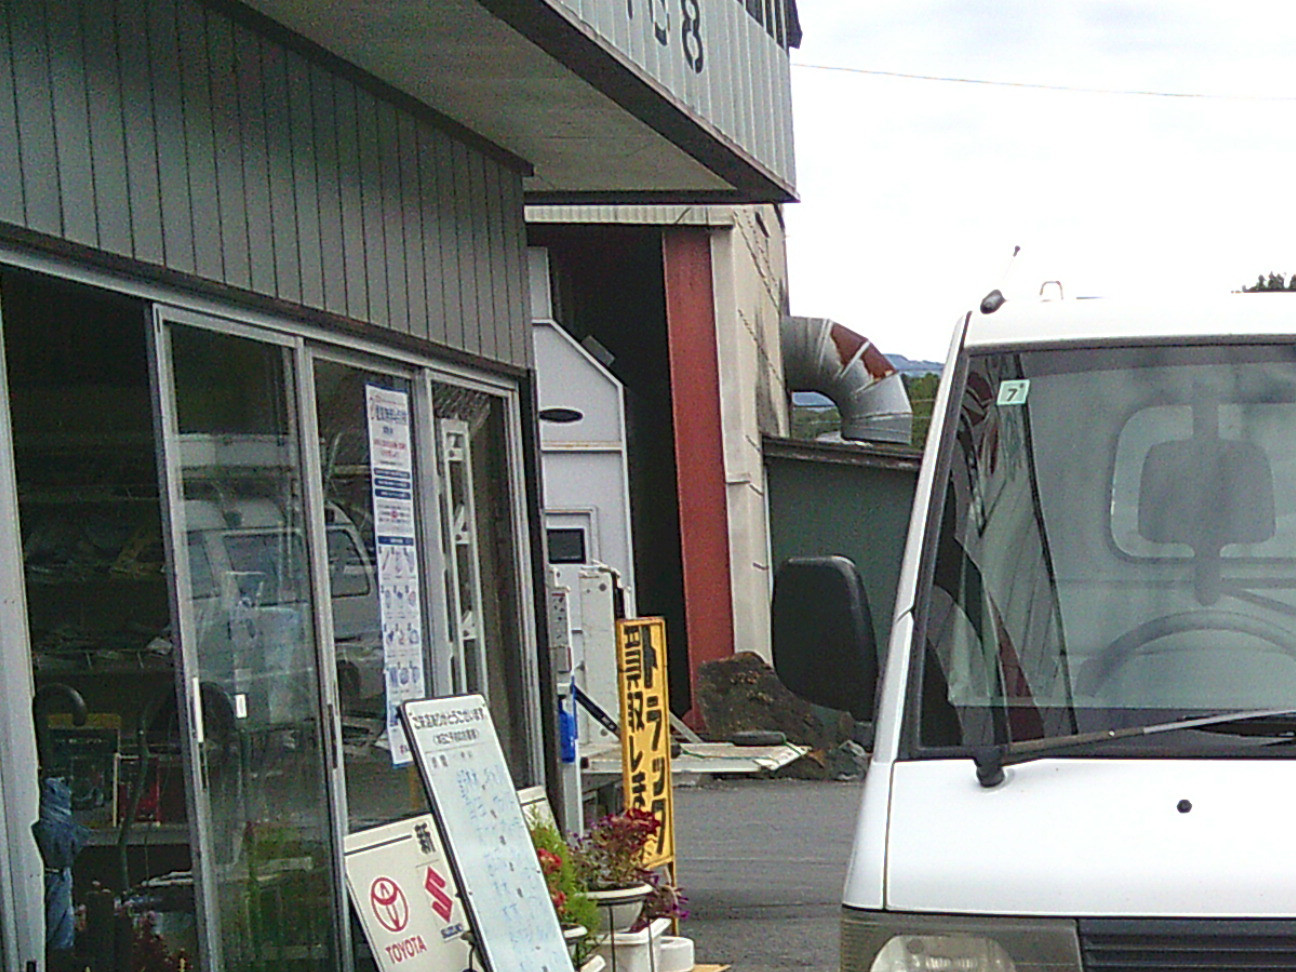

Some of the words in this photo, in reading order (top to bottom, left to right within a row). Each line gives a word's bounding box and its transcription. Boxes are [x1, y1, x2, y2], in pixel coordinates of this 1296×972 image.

[1007, 389, 1018, 401] 7
[642, 624, 666, 855] トラック
[385, 935, 428, 964] TOYOTA
